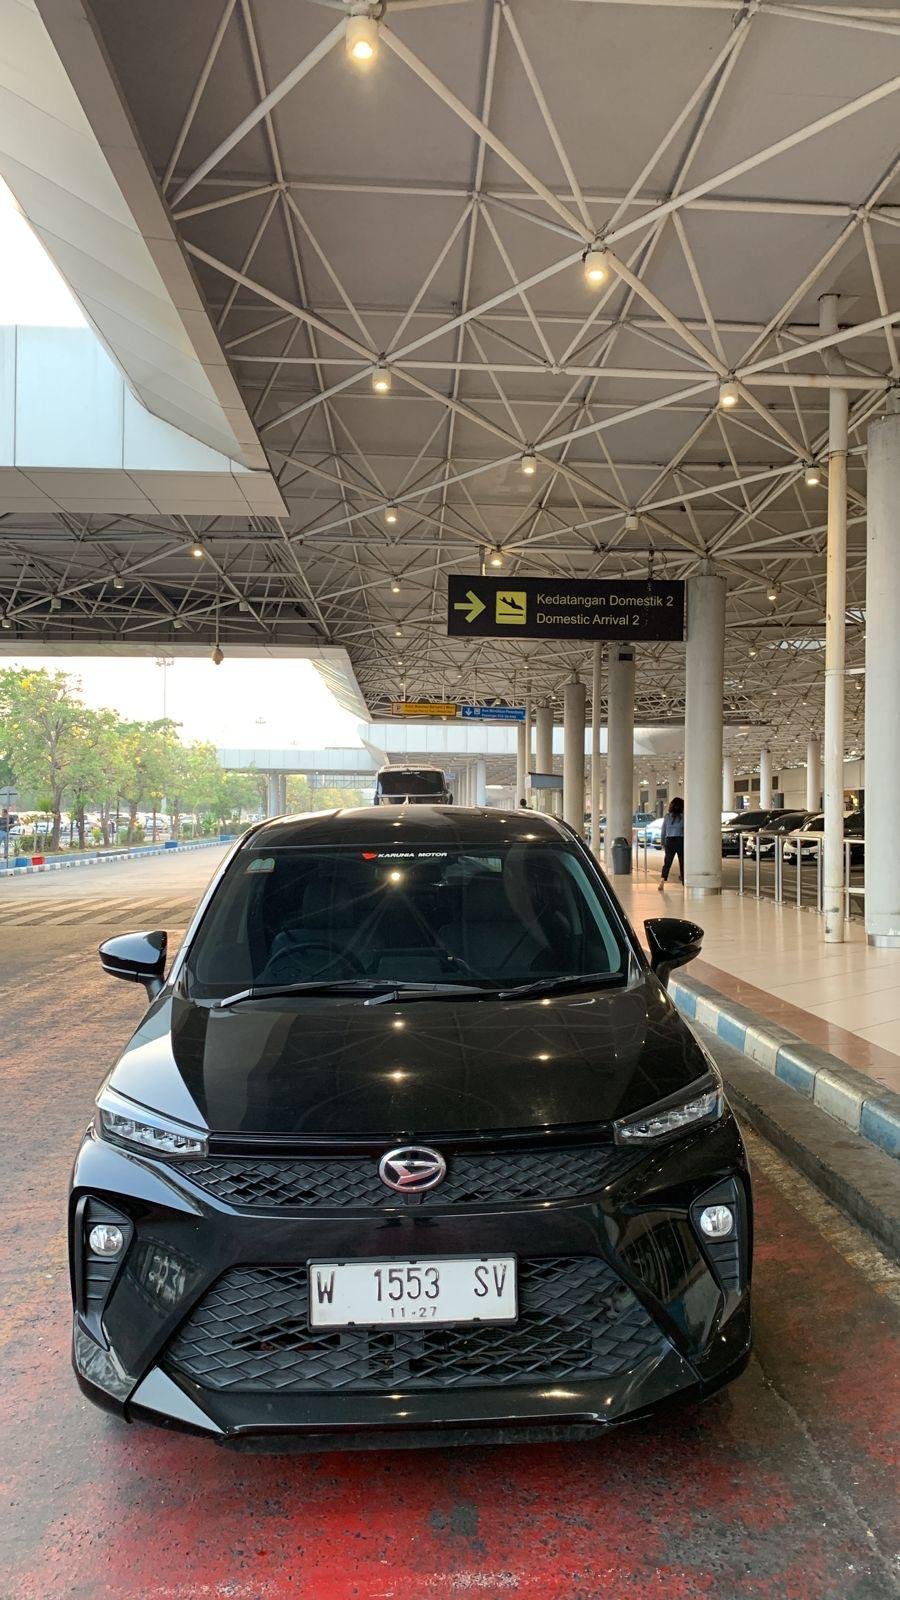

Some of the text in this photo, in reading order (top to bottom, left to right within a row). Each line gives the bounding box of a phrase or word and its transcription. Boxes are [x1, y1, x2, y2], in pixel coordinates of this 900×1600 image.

[537, 594, 674, 608] Kedatangan Domestik 2
[537, 613, 640, 626] Domestic Arrival 2
[316, 1263, 508, 1304] W 1553 SV
[390, 1306, 437, 1318] 11-27
